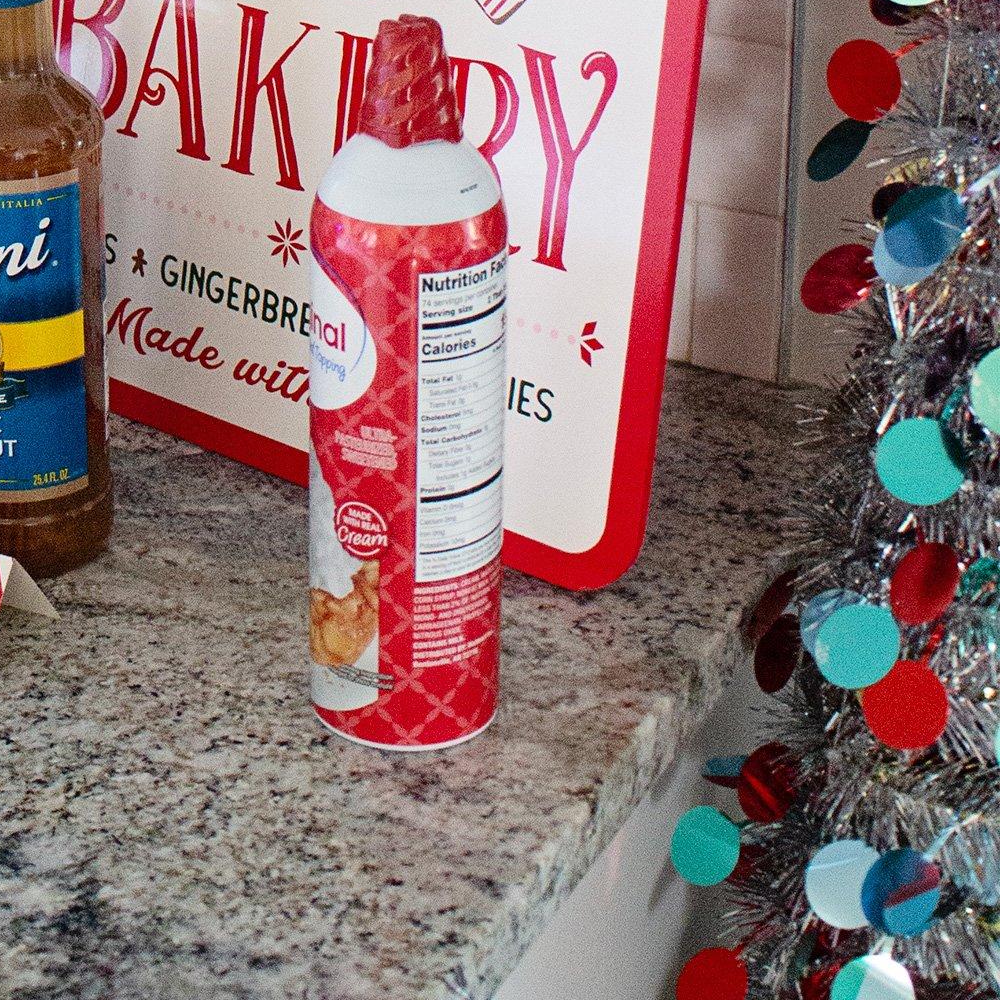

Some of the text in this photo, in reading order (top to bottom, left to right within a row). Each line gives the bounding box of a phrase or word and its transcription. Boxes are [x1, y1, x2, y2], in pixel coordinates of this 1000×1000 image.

[421, 269, 488, 293] Nutrition
[161, 255, 311, 337] GINGERBRE
[422, 304, 473, 320] Serving size
[106, 297, 225, 370] Made
[421, 337, 477, 356] Calories
[421, 425, 448, 434] Sodium
[338, 525, 388, 547] Cream
